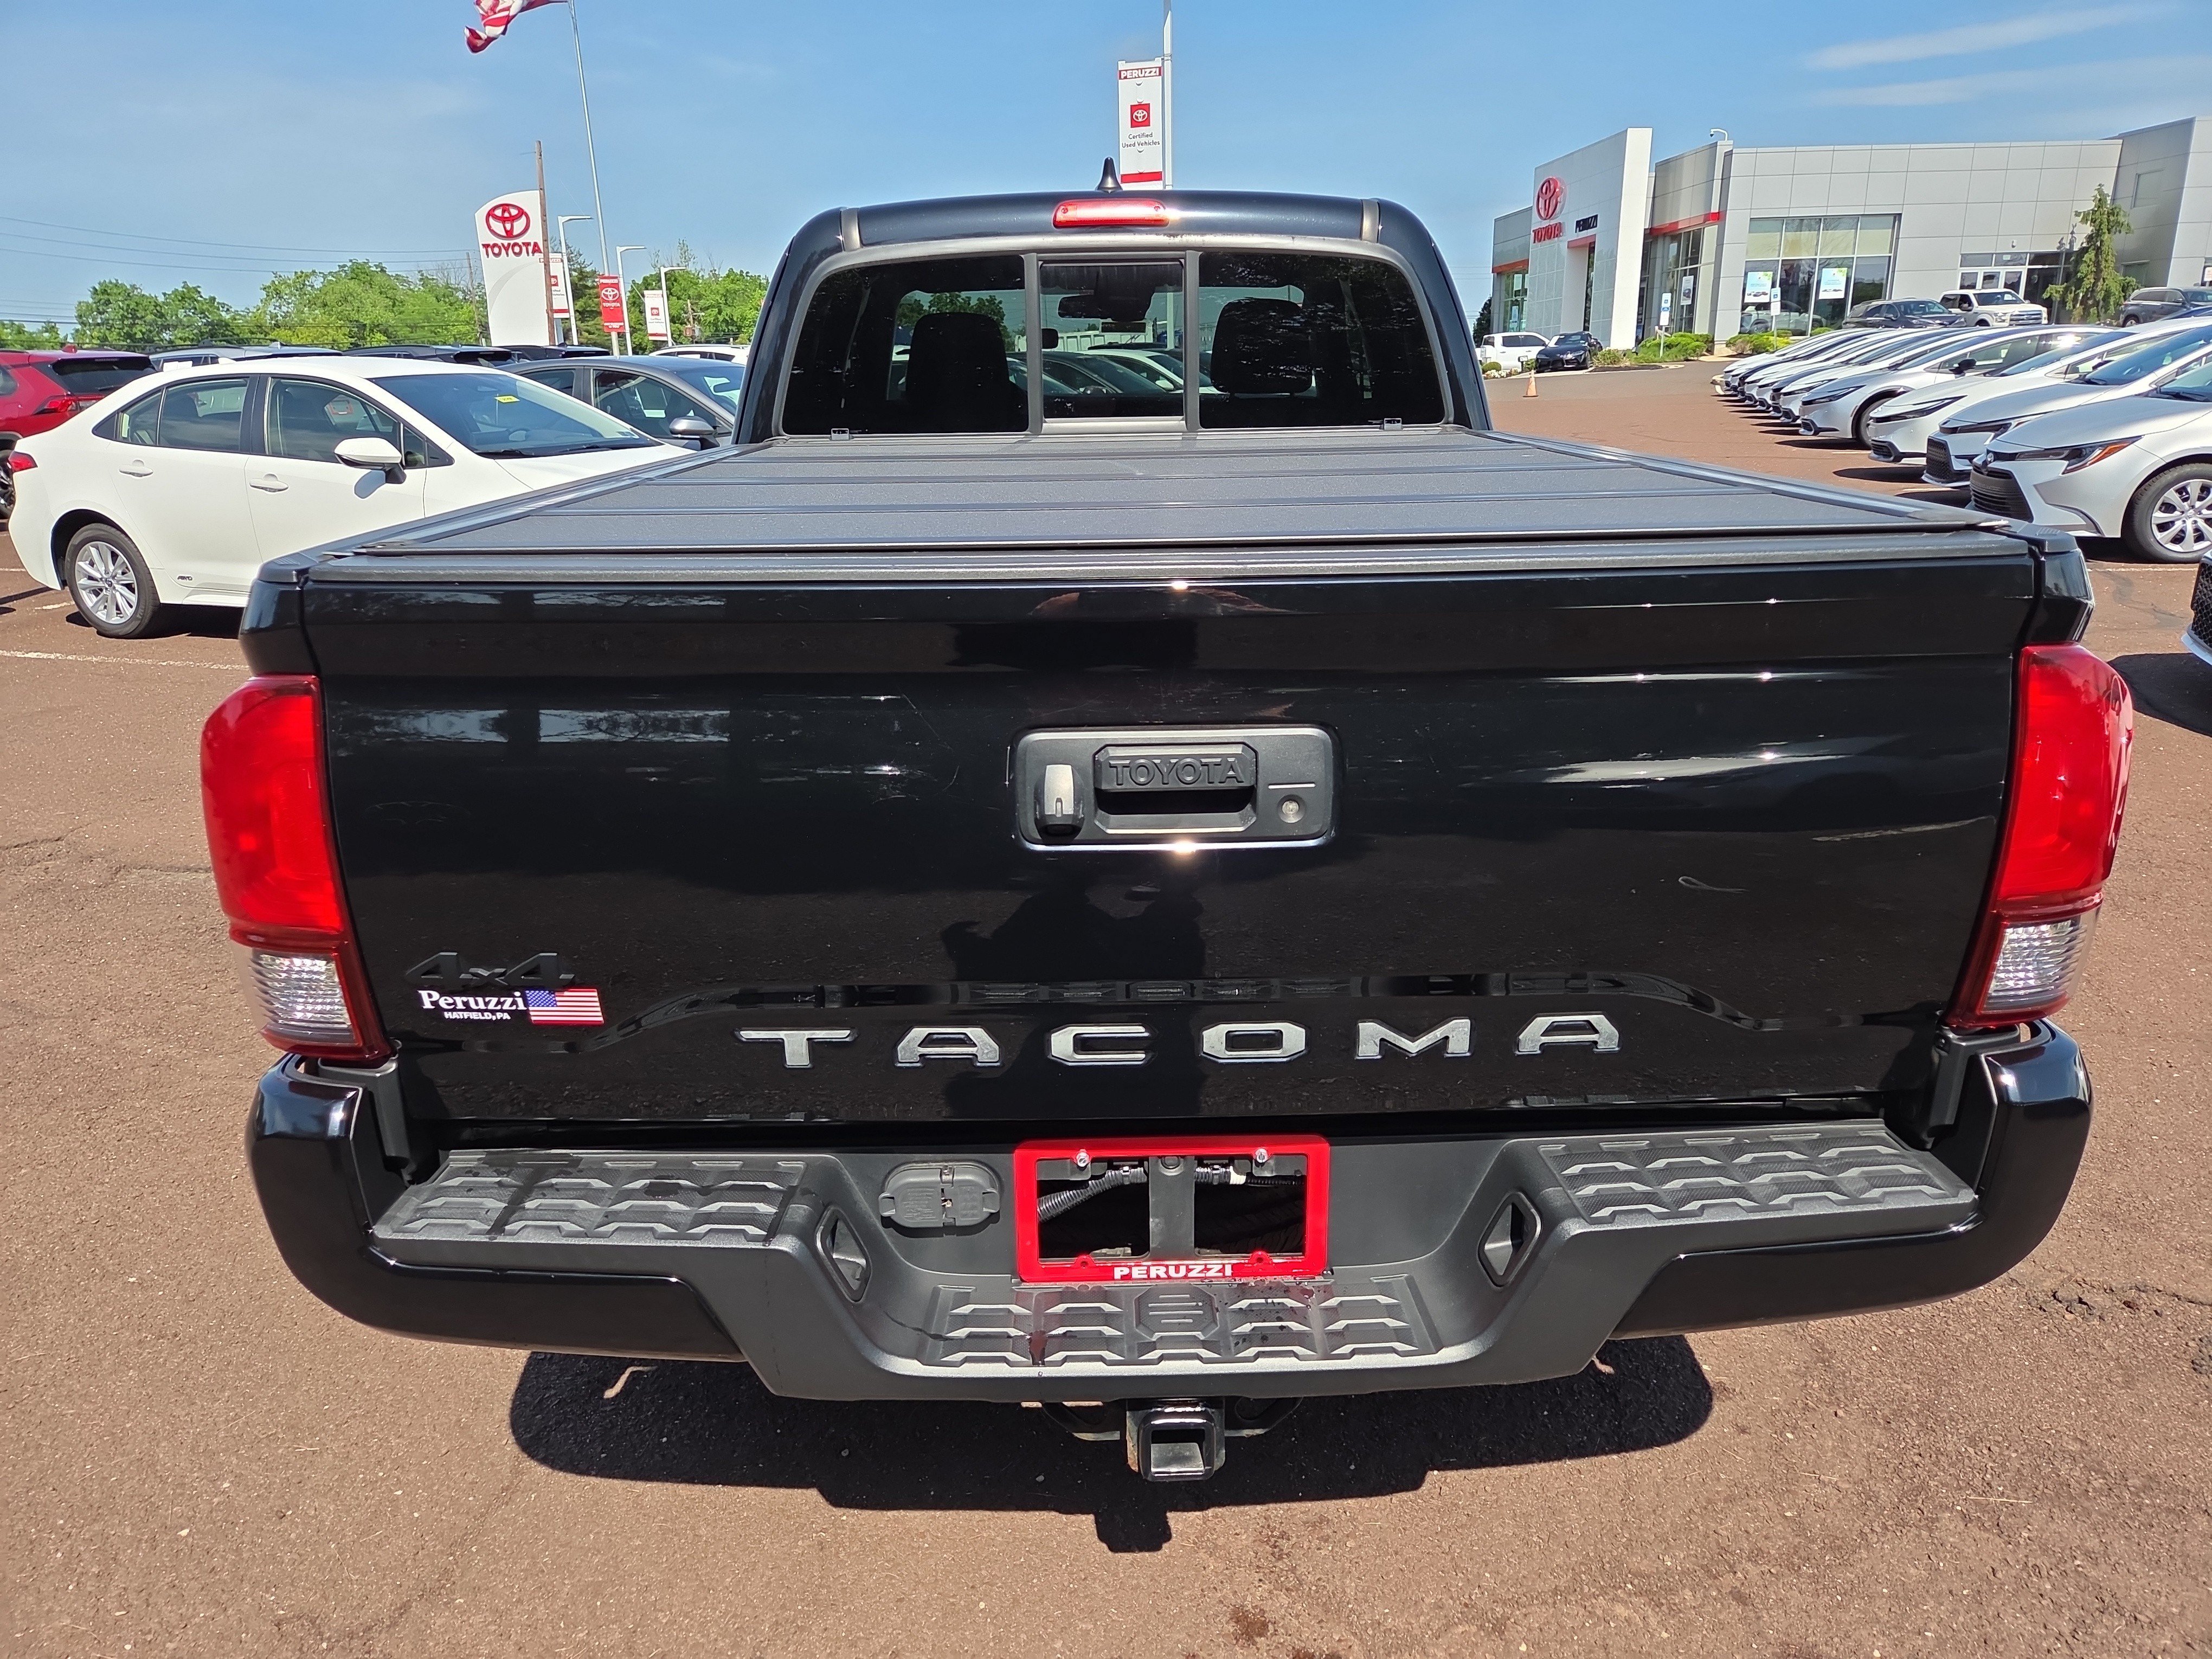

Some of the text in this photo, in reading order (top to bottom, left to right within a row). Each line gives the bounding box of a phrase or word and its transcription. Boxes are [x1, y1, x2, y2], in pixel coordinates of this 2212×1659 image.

[1121, 68, 1159, 79] PERUZZI
[1532, 222, 1563, 243] TOYOTA
[481, 241, 543, 259] TOYOTA
[1109, 757, 1244, 786] TOYOTA
[417, 990, 527, 1010] Peruzzi
[737, 1013, 1620, 1068] TACOMA
[1114, 1264, 1232, 1280] PERUZZI
